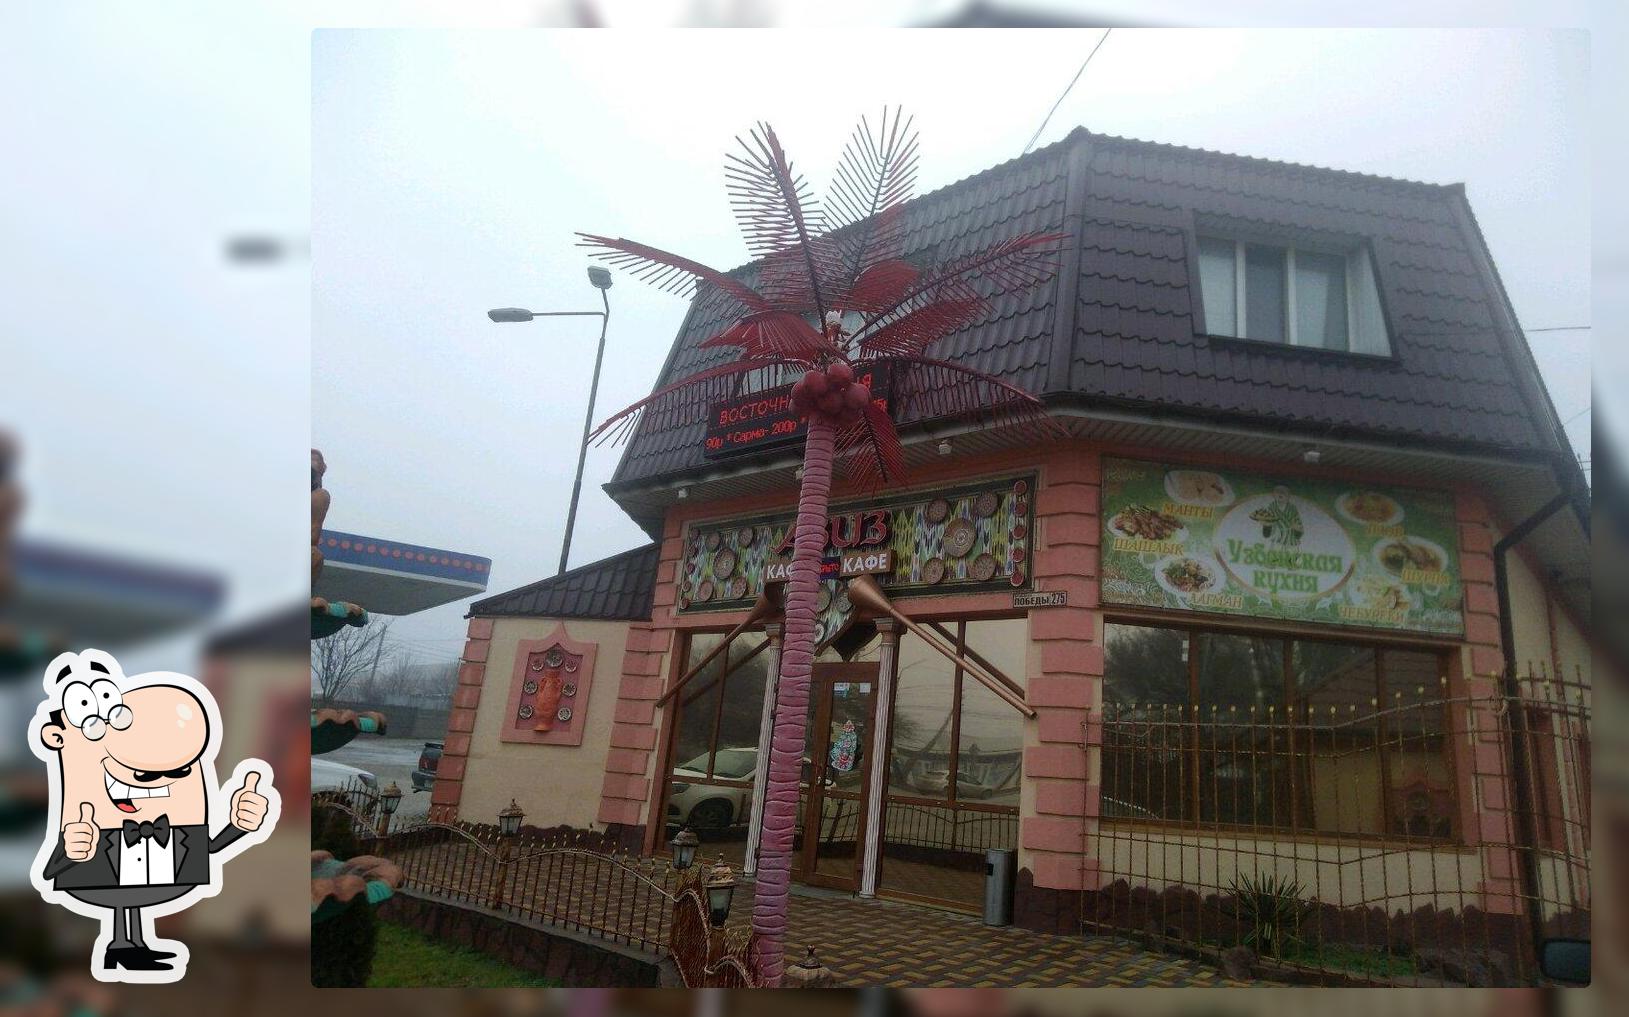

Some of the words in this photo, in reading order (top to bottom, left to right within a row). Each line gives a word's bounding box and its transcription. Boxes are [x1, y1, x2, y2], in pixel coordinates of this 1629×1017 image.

[719, 395, 790, 424] ВОСТОЧН
[1163, 503, 1214, 518] МАНТЫ
[1113, 538, 1185, 556] ШАШЛЫК
[1227, 538, 1342, 573] Узбекская
[843, 553, 887, 573] КАФЕ
[1014, 597, 1048, 606] ПОБЕДЫ
[1050, 592, 1066, 604] 275
[1189, 592, 1243, 608] ЛАГМАН
